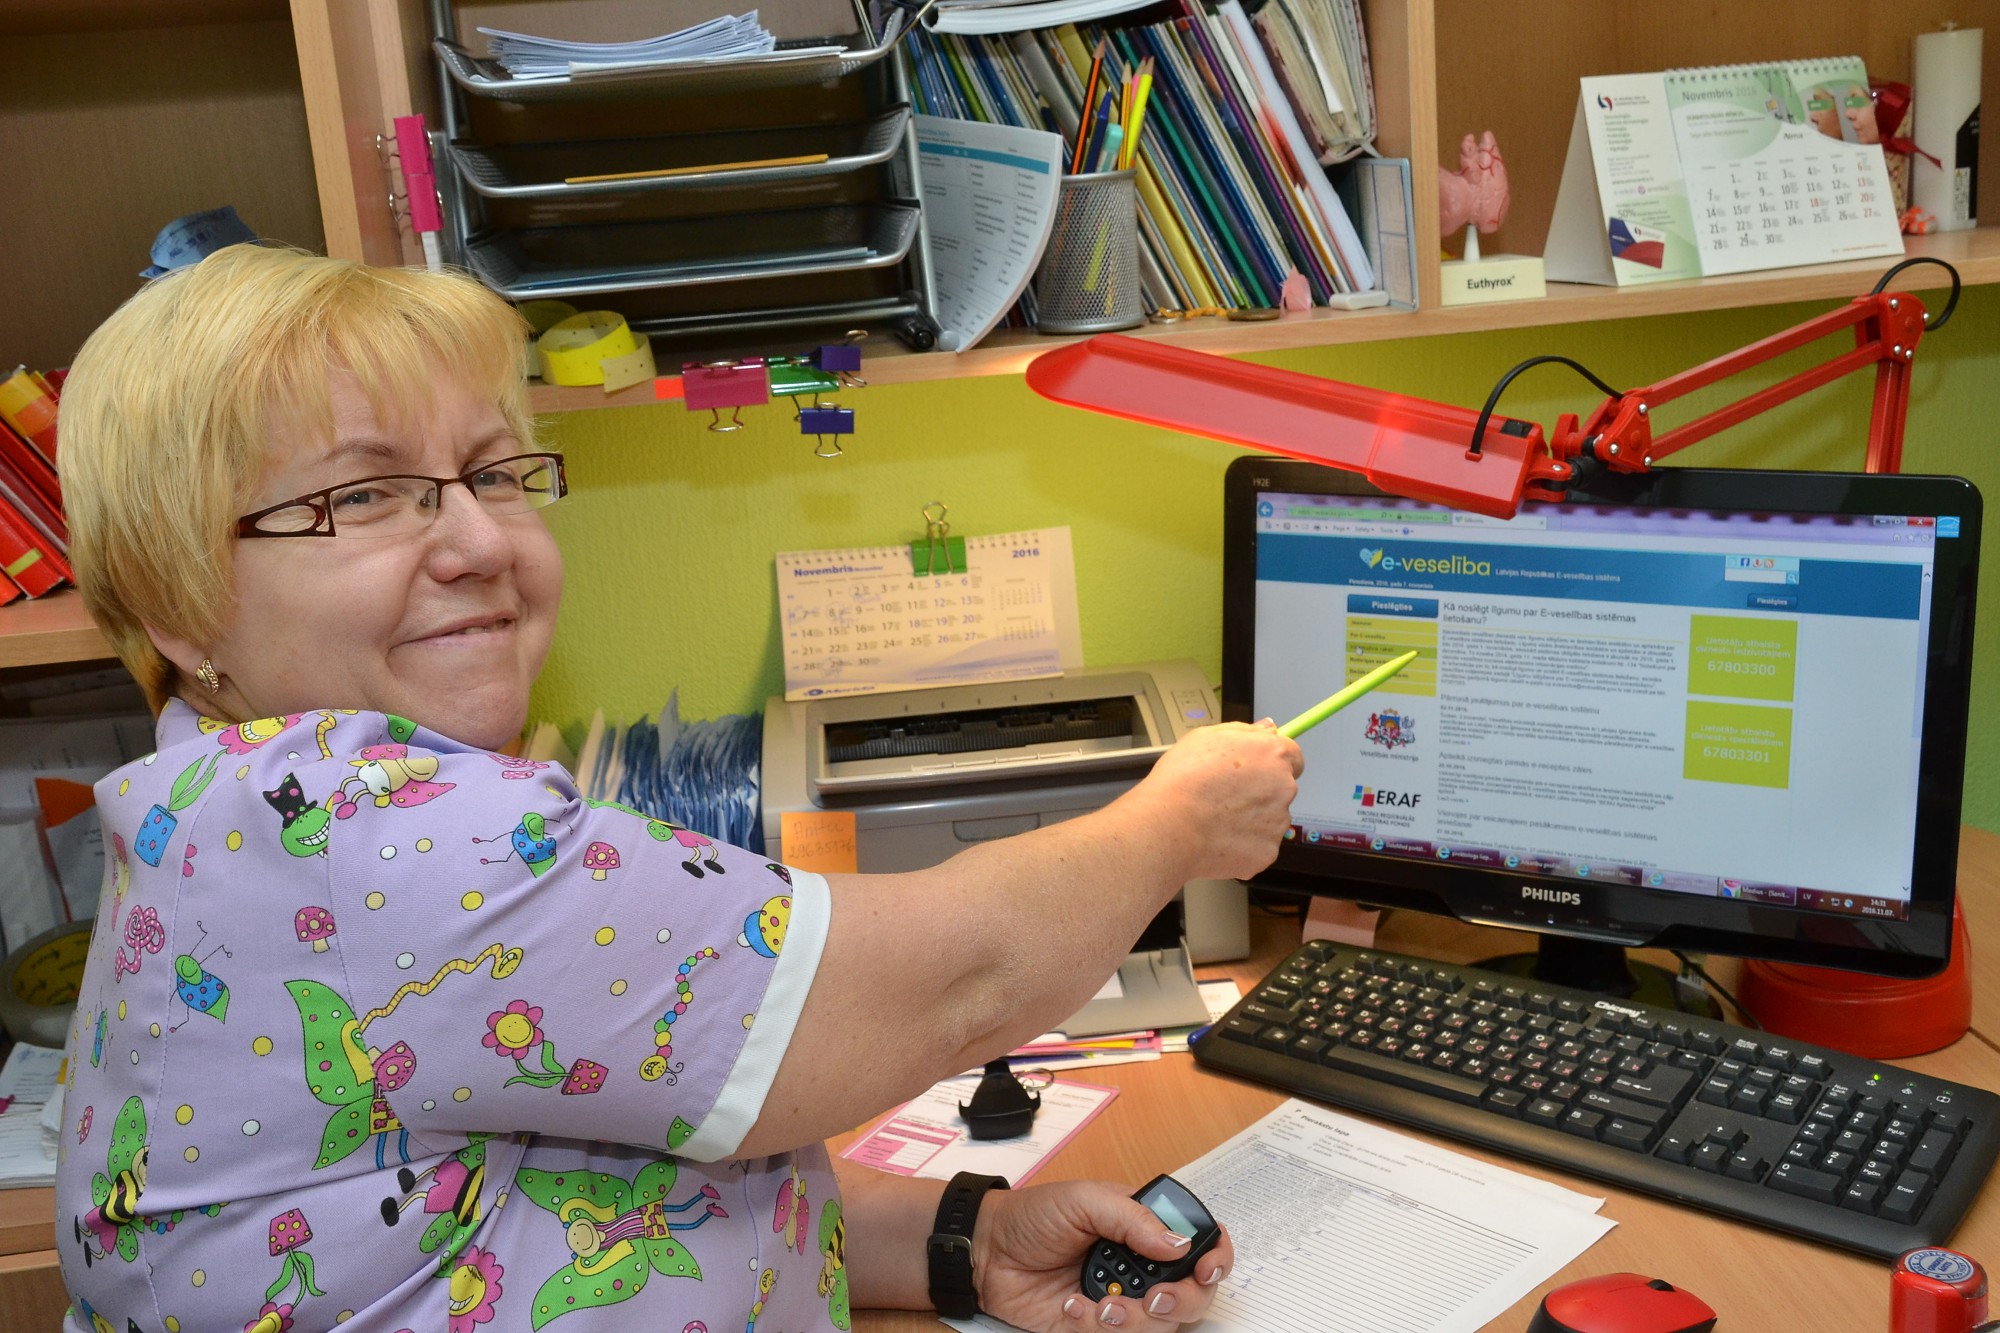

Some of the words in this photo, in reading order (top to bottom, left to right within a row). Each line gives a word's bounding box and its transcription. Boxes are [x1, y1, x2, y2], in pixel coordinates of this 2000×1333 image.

[1682, 88, 1733, 102] Novembris
[1731, 173, 1736, 184] 1
[1757, 171, 1762, 181] 2
[1808, 166, 1813, 176] 4
[1832, 164, 1838, 174] 5
[1857, 162, 1863, 172] 6
[1734, 188, 1740, 199] 8
[1760, 186, 1765, 197] 9
[1781, 184, 1791, 195] 10
[1806, 182, 1816, 192] 11
[1832, 179, 1841, 190] 12
[1706, 208, 1716, 218] 14
[1733, 204, 1742, 216] 15
[1759, 202, 1768, 213] 16
[1784, 200, 1793, 210] 17
[1810, 198, 1820, 208] 18
[1835, 195, 1844, 206] 19
[1710, 224, 1720, 234] 21
[1736, 220, 1746, 231] 22
[1762, 218, 1772, 229] 23
[1788, 216, 1797, 226] 24
[1813, 212, 1822, 224] 25
[1838, 210, 1848, 221] 26
[1864, 208, 1872, 218] 27
[1012, 548, 1040, 558] 2016
[794, 565, 853, 577] Novembris
[1382, 554, 1491, 576] e-veselība
[1495, 568, 1520, 578] Latvijas
[1520, 569, 1556, 580] Republikas
[1556, 571, 1594, 581] E-veselības
[828, 588, 832, 598] 1
[854, 586, 860, 596] 2
[882, 584, 887, 594] 3
[908, 582, 914, 590] 4
[934, 579, 941, 588] 5
[961, 577, 968, 586] 6
[828, 608, 836, 618] 8
[856, 606, 862, 614] 9
[880, 603, 892, 612] 10
[908, 600, 918, 610] 11
[934, 598, 946, 608] 12
[961, 596, 972, 605] 13
[1372, 601, 1414, 612] Pieslēgties
[1444, 602, 1456, 611] Kā
[1458, 604, 1489, 614] noslēgt
[1492, 606, 1521, 616] līgumu
[1523, 608, 1538, 618] par
[1540, 608, 1593, 620] E-veselības
[1595, 612, 1637, 623] sistēmas
[802, 629, 813, 638] 14
[828, 626, 840, 636] 15
[855, 624, 867, 633] 16
[882, 622, 893, 631] 17
[909, 620, 920, 628] 18
[936, 617, 948, 626] 19
[962, 614, 975, 624] 20
[1443, 614, 1488, 625] lietošanu?
[802, 647, 813, 656] 21
[829, 645, 840, 653] 22
[856, 642, 868, 651] 23
[883, 639, 895, 649] 24
[911, 637, 922, 646] 25
[938, 635, 949, 644] 26
[964, 632, 976, 641] 27
[1708, 660, 1776, 676] 67803300
[1703, 746, 1771, 763] 67803301
[1376, 790, 1422, 808] ERAF
[1522, 886, 1581, 906] PHILIPS
[1594, 1000, 1642, 1018] Chicony
[1439, 1051, 1449, 1059] N
[1756, 1070, 1773, 1078] Home
[1742, 1088, 1756, 1096] End
[1816, 1110, 1834, 1119] Home
[1887, 1128, 1905, 1136] PgUp
[1863, 1168, 1881, 1177] PgDn
[1850, 1189, 1862, 1197] Del
[1897, 1185, 1915, 1194] Enter
[1118, 1263, 1126, 1271] 8
[1096, 1270, 1104, 1278] 0
[1132, 1278, 1140, 1286] 9
